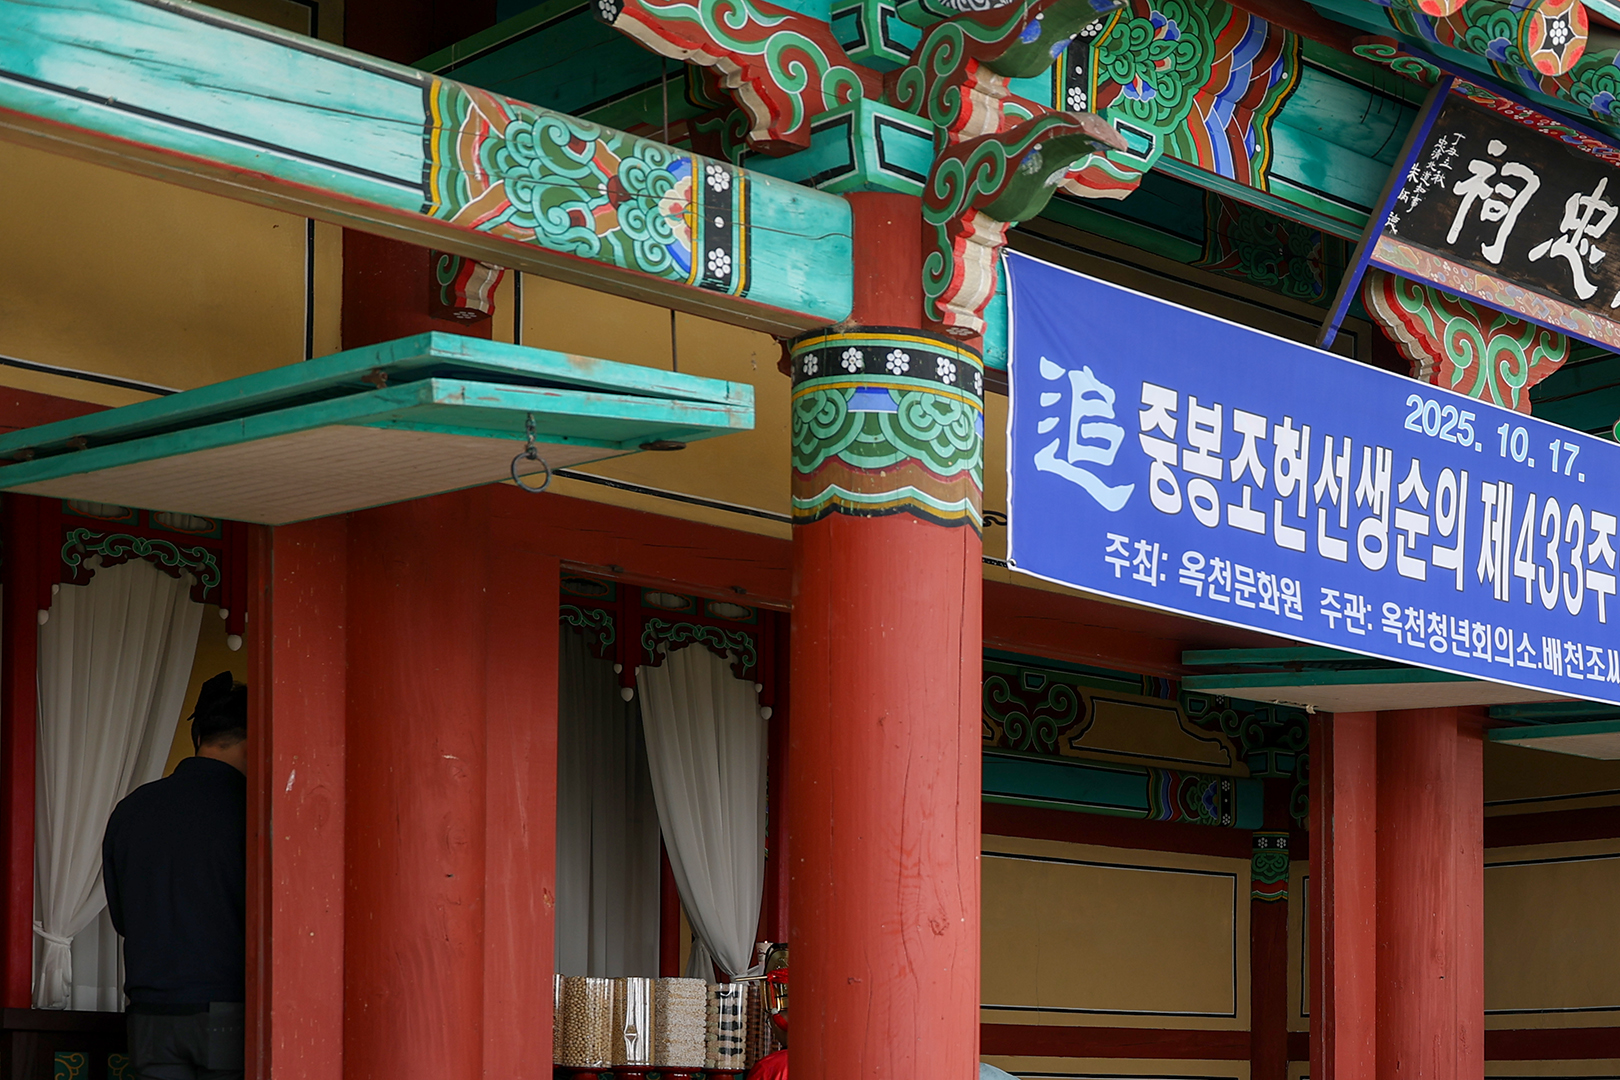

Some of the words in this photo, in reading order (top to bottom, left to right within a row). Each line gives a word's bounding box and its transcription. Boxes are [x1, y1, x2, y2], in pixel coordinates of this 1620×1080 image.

[1034, 356, 1135, 512] 追
[1138, 380, 1468, 592] 중봉조헌선생순의
[1404, 394, 1482, 452] 2025.
[1497, 423, 1535, 468] 10.
[1549, 439, 1585, 483] 17.
[1104, 532, 1168, 587] 주최:
[1178, 550, 1303, 621] 옥천문화원
[1320, 587, 1373, 635] 주관:
